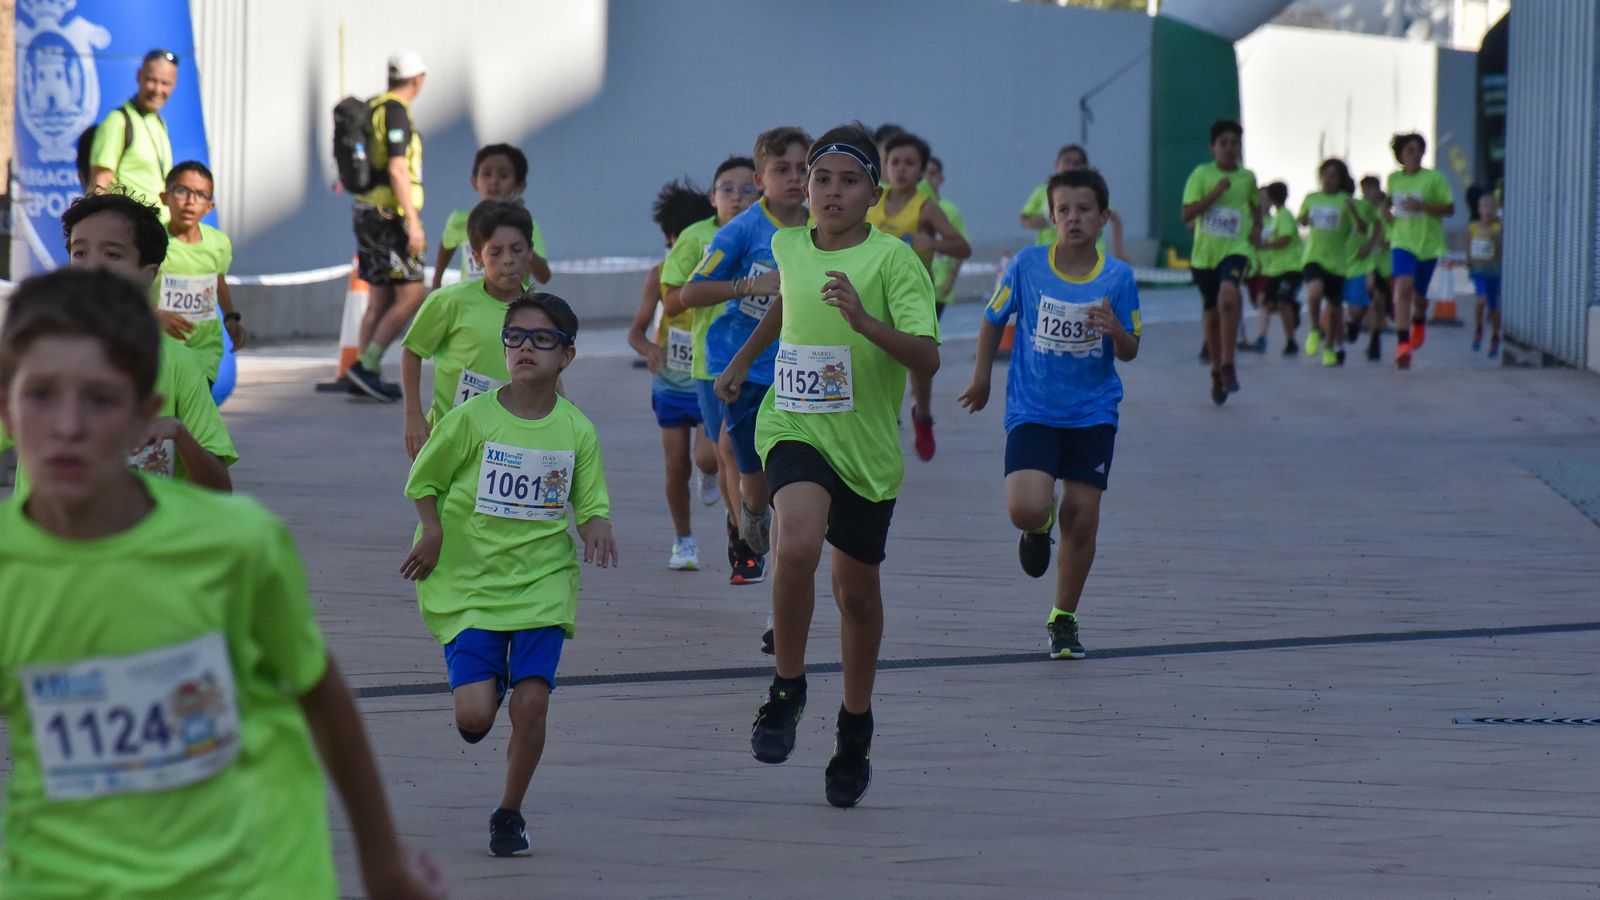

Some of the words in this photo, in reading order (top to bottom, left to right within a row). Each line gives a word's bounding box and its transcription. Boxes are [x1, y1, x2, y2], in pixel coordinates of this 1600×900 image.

[165, 291, 202, 309] 1205
[1042, 316, 1083, 339] 1263
[779, 367, 819, 394] 1152
[487, 448, 504, 462] XXI
[486, 469, 542, 501] 1061
[46, 702, 171, 760] 1124
